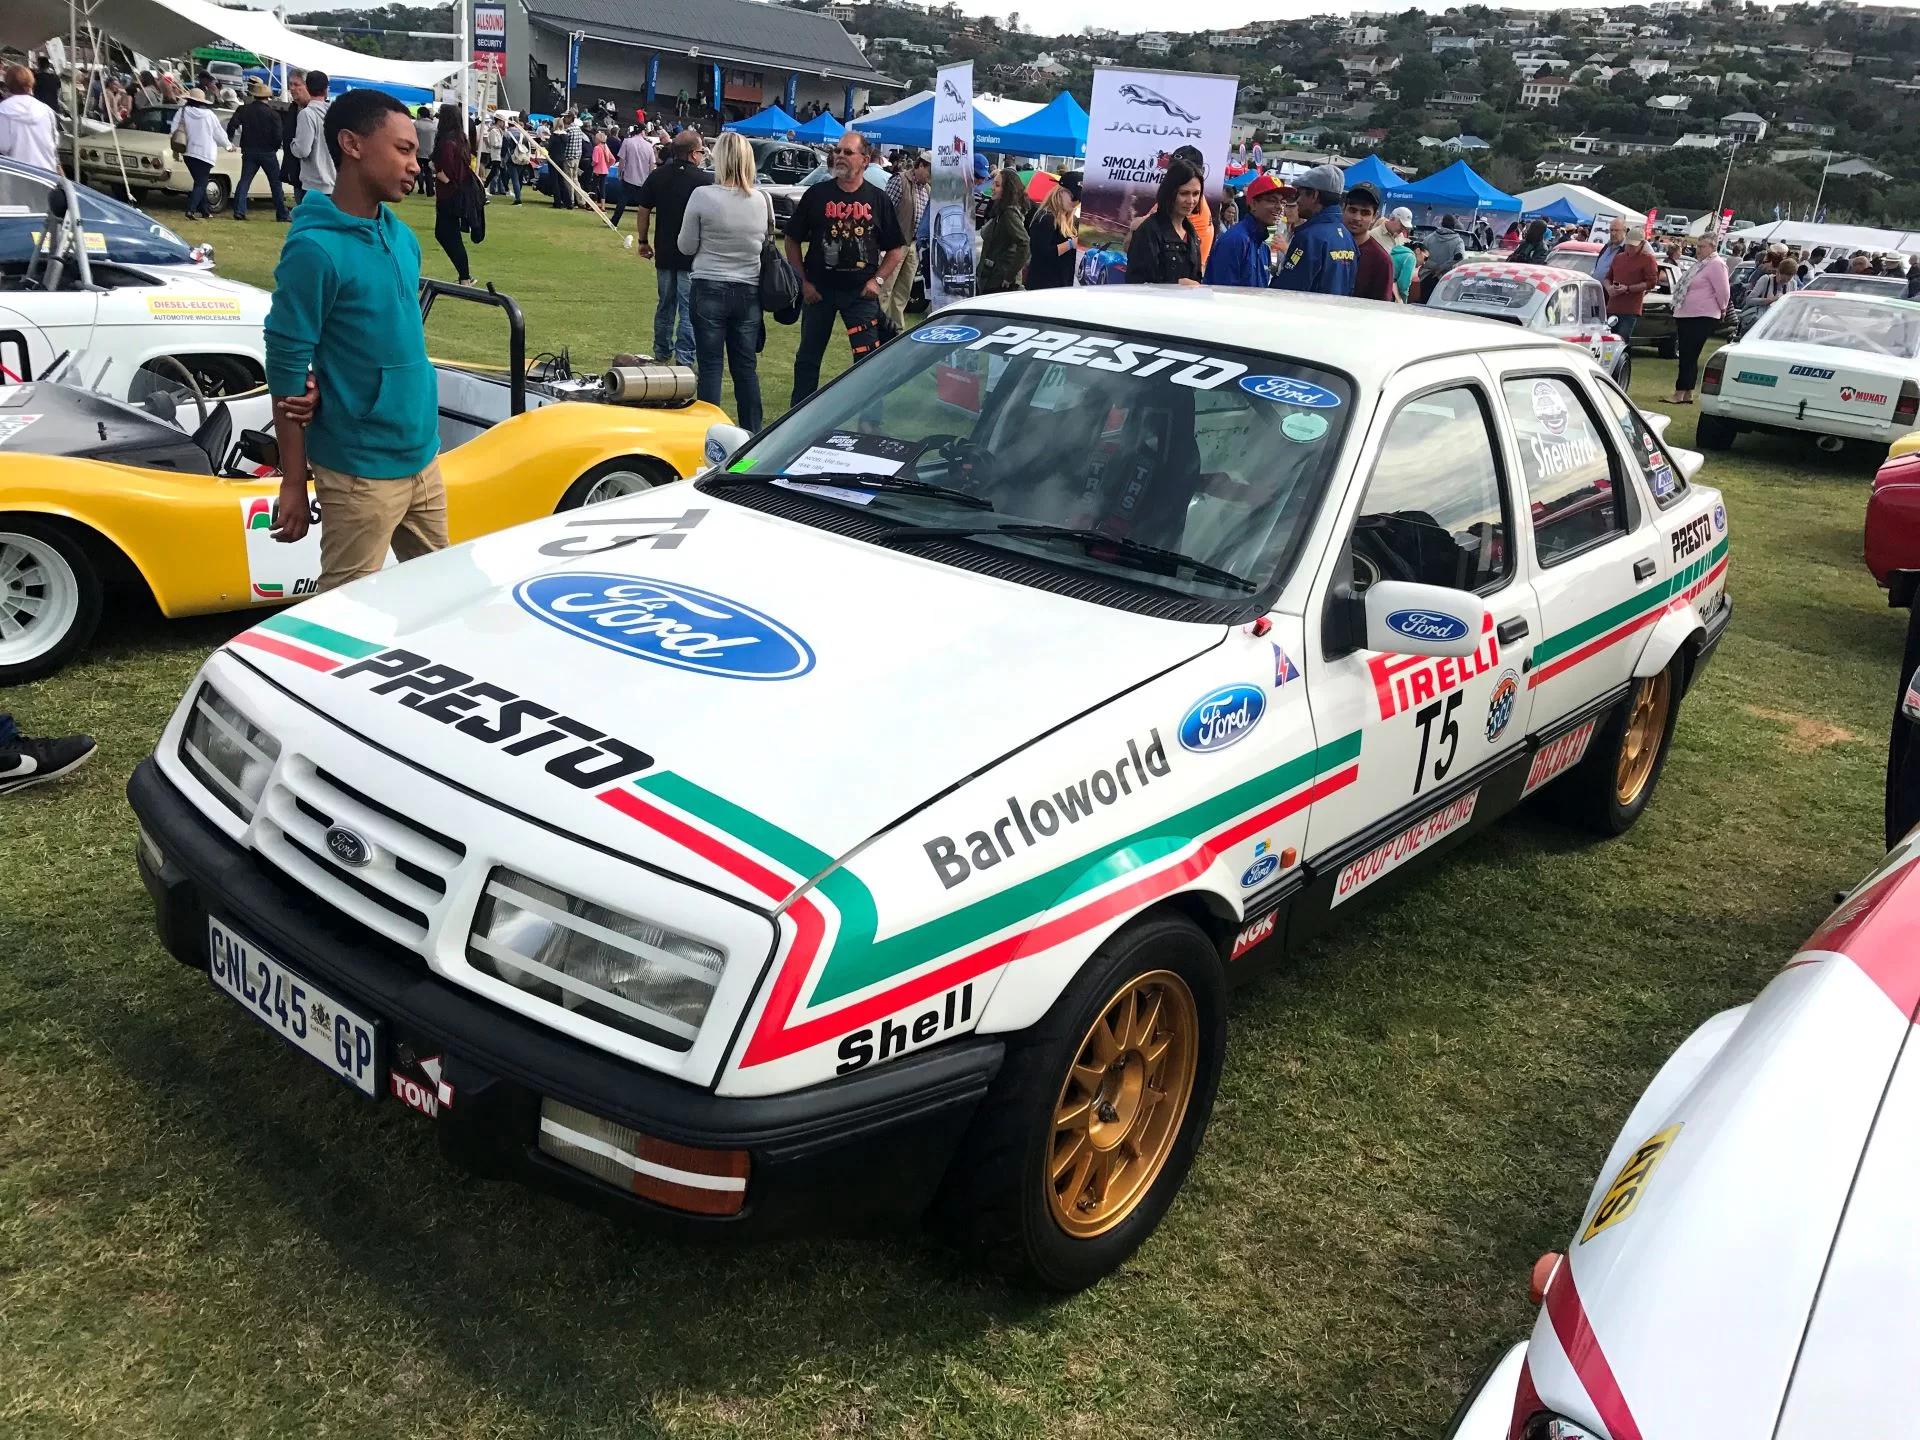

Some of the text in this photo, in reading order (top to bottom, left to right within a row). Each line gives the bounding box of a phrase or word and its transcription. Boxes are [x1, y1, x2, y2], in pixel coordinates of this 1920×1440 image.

[477, 14, 504, 31] ALLSOUND
[477, 38, 502, 48] SECURITY
[938, 111, 967, 123] JAGUAR
[1104, 121, 1202, 139] JAGUAR
[976, 134, 1001, 145] Sanlam
[1102, 155, 1146, 170] SIMOLA
[825, 201, 873, 221] AC/DC
[153, 313, 193, 321] AUTOMOTIVE
[154, 300, 235, 310] DIESEL-ELECTRIC
[920, 328, 969, 341] Ford
[965, 326, 1248, 390] PRESTO
[1790, 366, 1834, 379] FIAT
[1254, 379, 1324, 404] Ford
[538, 508, 711, 557] T5
[1671, 513, 1712, 563] PRESTO
[551, 585, 762, 658] Ford
[1401, 613, 1454, 638] Ford
[1366, 611, 1500, 721] PIRELLI
[331, 648, 655, 791] PRESTO
[1199, 694, 1252, 746] Ford
[1413, 688, 1465, 795] T5
[922, 728, 1172, 890] Barloworld
[331, 832, 358, 858] Ford
[1339, 789, 1477, 895] GROUP ONE RACING
[1247, 859, 1273, 885] Ford
[1232, 911, 1274, 954] NGK
[334, 1013, 372, 1079] GP
[835, 983, 973, 1076] Shell
[392, 1073, 439, 1119] TOW
[1591, 1136, 1665, 1228] ATS
